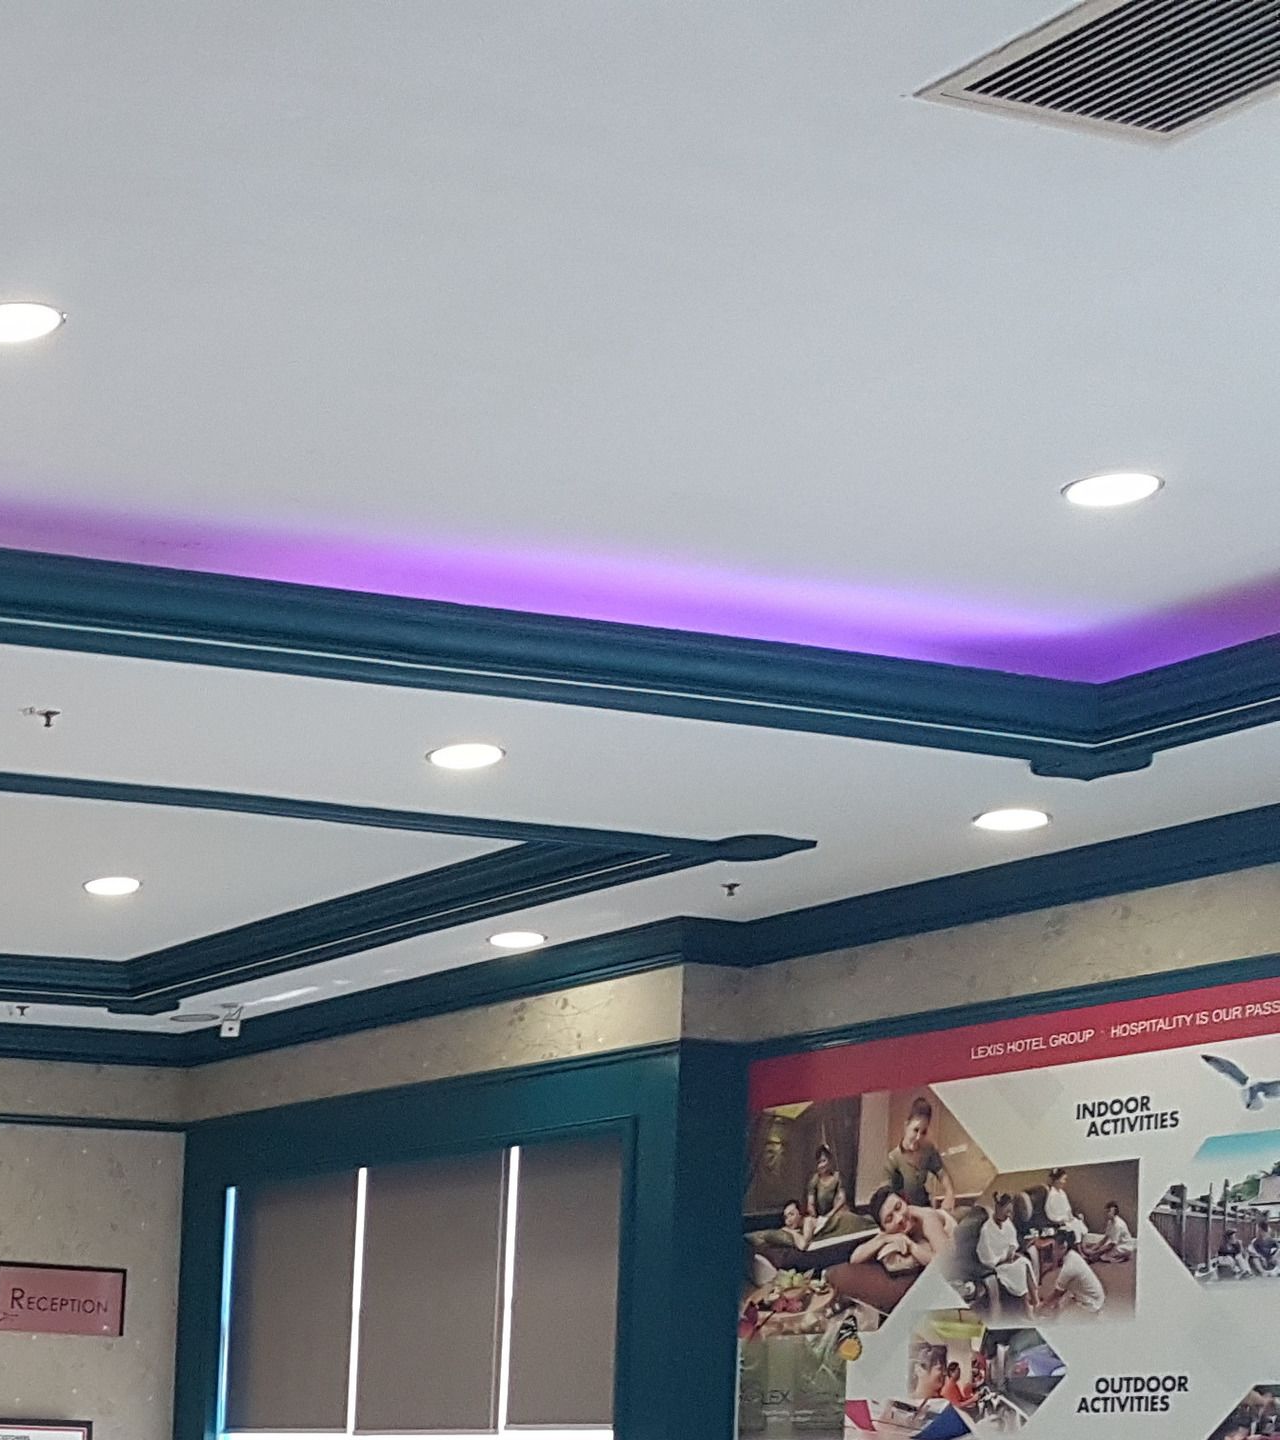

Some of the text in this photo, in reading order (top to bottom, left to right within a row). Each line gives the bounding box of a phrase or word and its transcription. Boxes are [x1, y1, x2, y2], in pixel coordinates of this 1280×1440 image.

[971, 1043, 1004, 1060] LEXIS
[1007, 1037, 1046, 1055] HOTEL
[1049, 1029, 1095, 1047] GROUP
[1111, 1013, 1193, 1038] HOSPITALITY
[1196, 1012, 1209, 1026] IS
[1212, 1005, 1242, 1023] OUR
[1076, 1095, 1151, 1120] INDOOR
[1086, 1110, 1180, 1137] ACTIVITIES
[1095, 1375, 1189, 1394] OUTDOOR
[1076, 1395, 1170, 1413] ACTIVITIES
